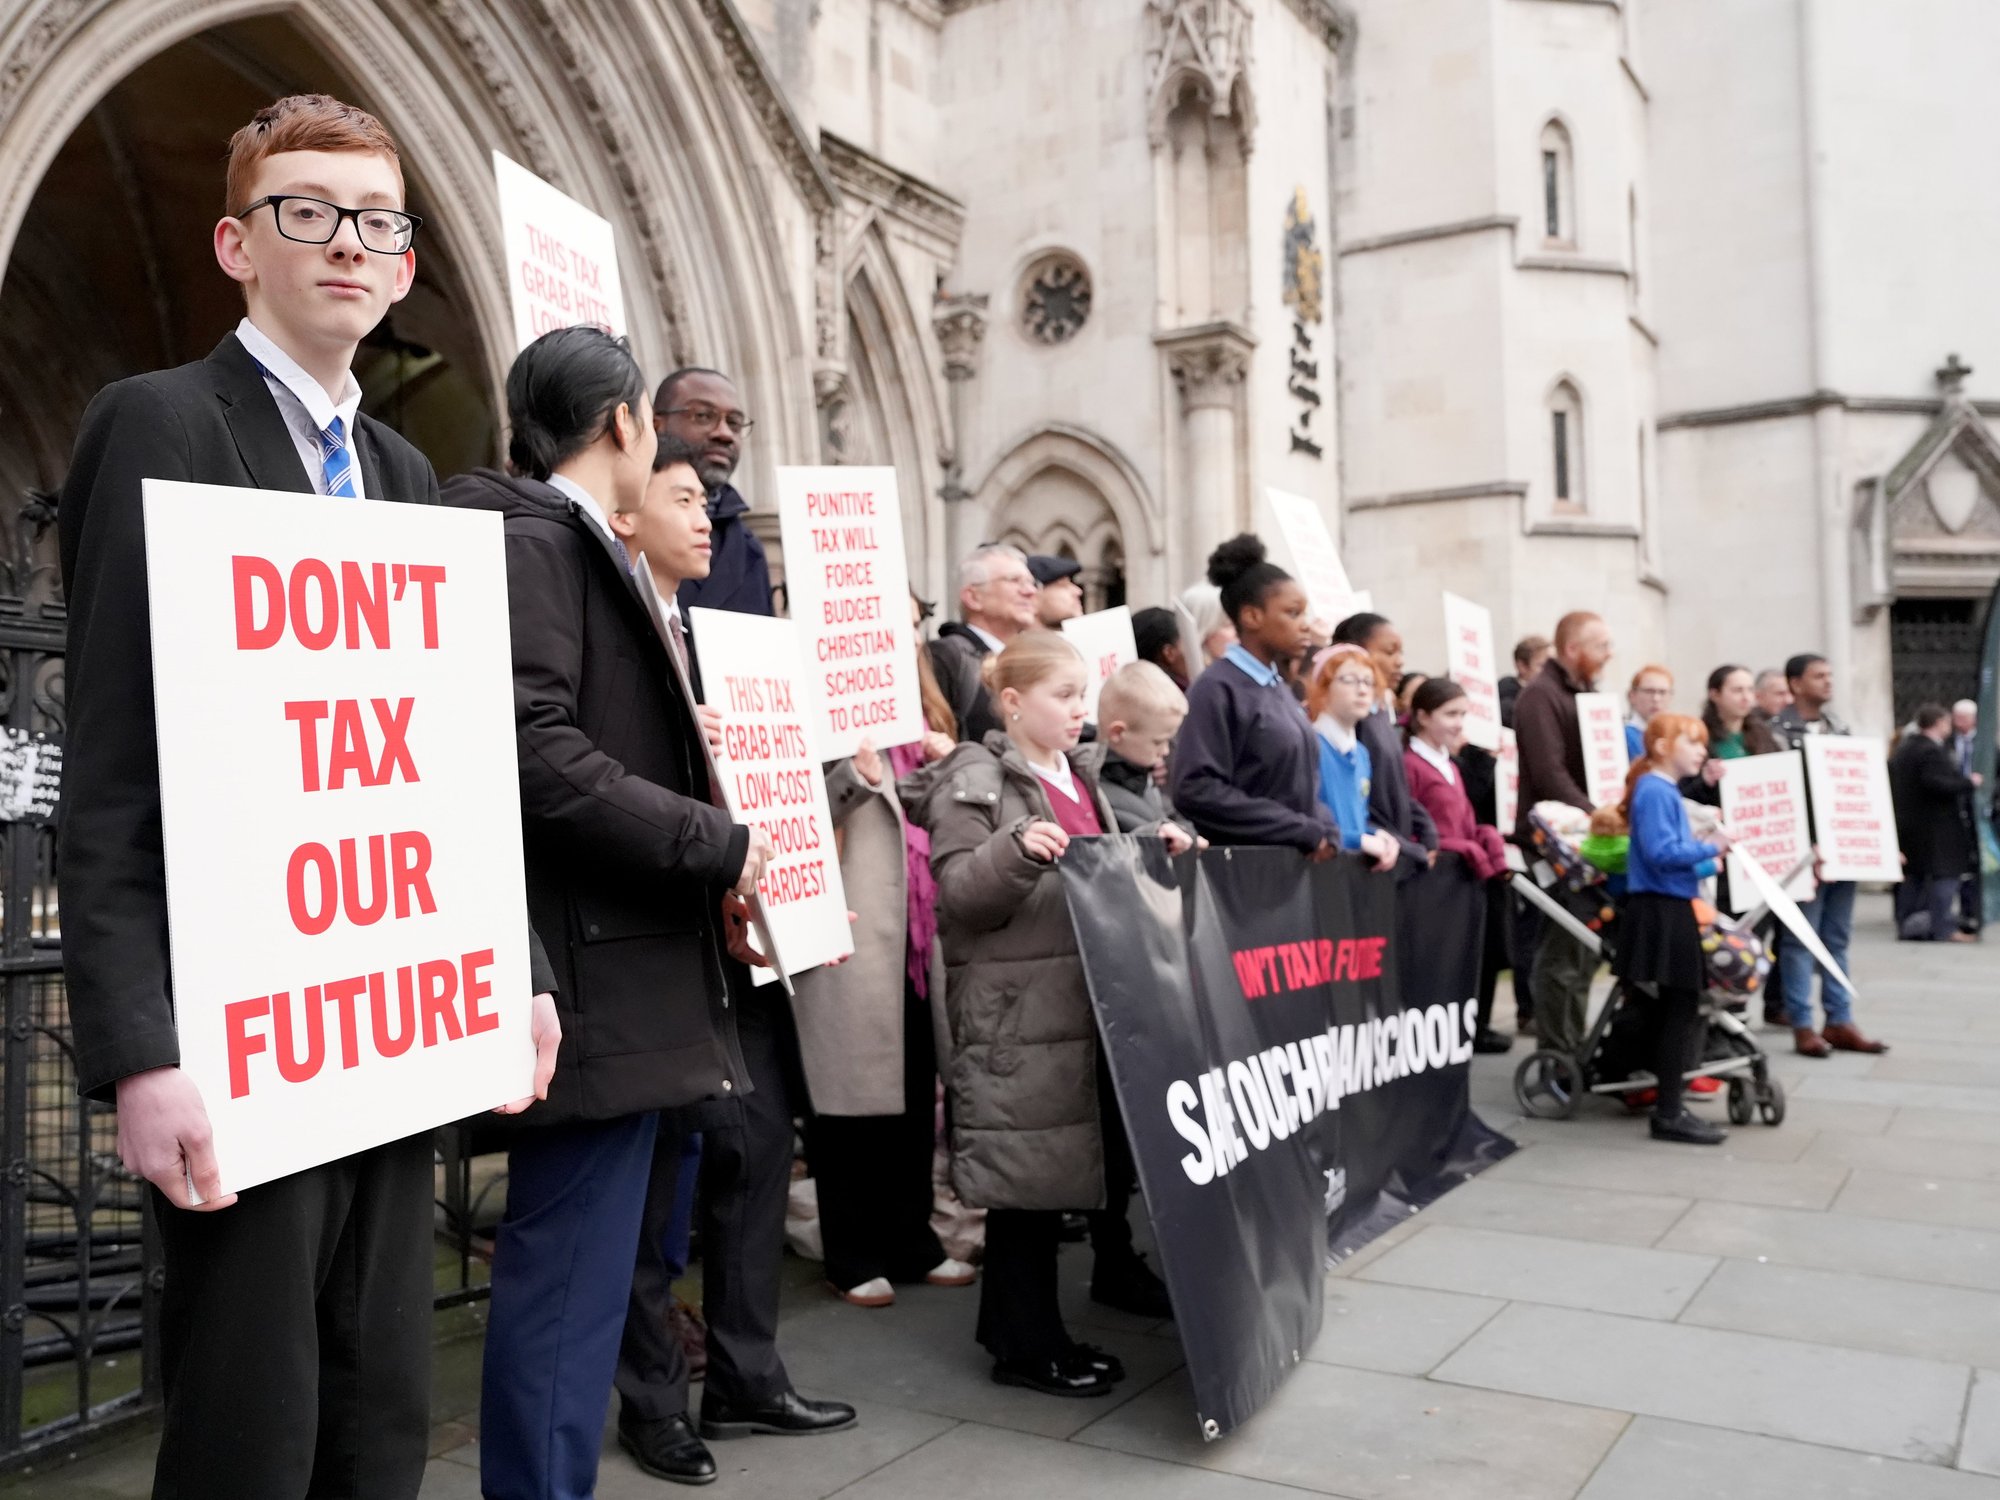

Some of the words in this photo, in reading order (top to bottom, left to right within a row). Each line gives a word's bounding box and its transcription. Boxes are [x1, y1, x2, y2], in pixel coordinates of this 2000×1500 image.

[525, 223, 569, 274] THIS
[569, 249, 602, 292] TAX
[521, 261, 571, 312] GRAB
[806, 491, 876, 519] PUNITIVE
[811, 527, 842, 553] TAX
[844, 523, 879, 550] WILL
[825, 561, 875, 588] FORCE
[231, 554, 447, 651] DON'T
[822, 596, 882, 625] BUDGET
[816, 630, 896, 663] CHRISTIAN
[724, 675, 764, 713] THIS
[764, 677, 795, 713] TAX
[825, 664, 895, 698] SCHOOLS
[828, 707, 848, 733] TO
[851, 698, 898, 729] CLOSE
[284, 696, 421, 793] TAX
[725, 724, 772, 762] GRAB
[773, 722, 807, 760] HITS
[735, 769, 815, 812] LOW-COST
[749, 815, 820, 855] HOOLS
[285, 830, 438, 936] OUR
[757, 861, 828, 907] HARDEST
[223, 947, 501, 1100] FUTURE
[1166, 1067, 1249, 1186] SAE
